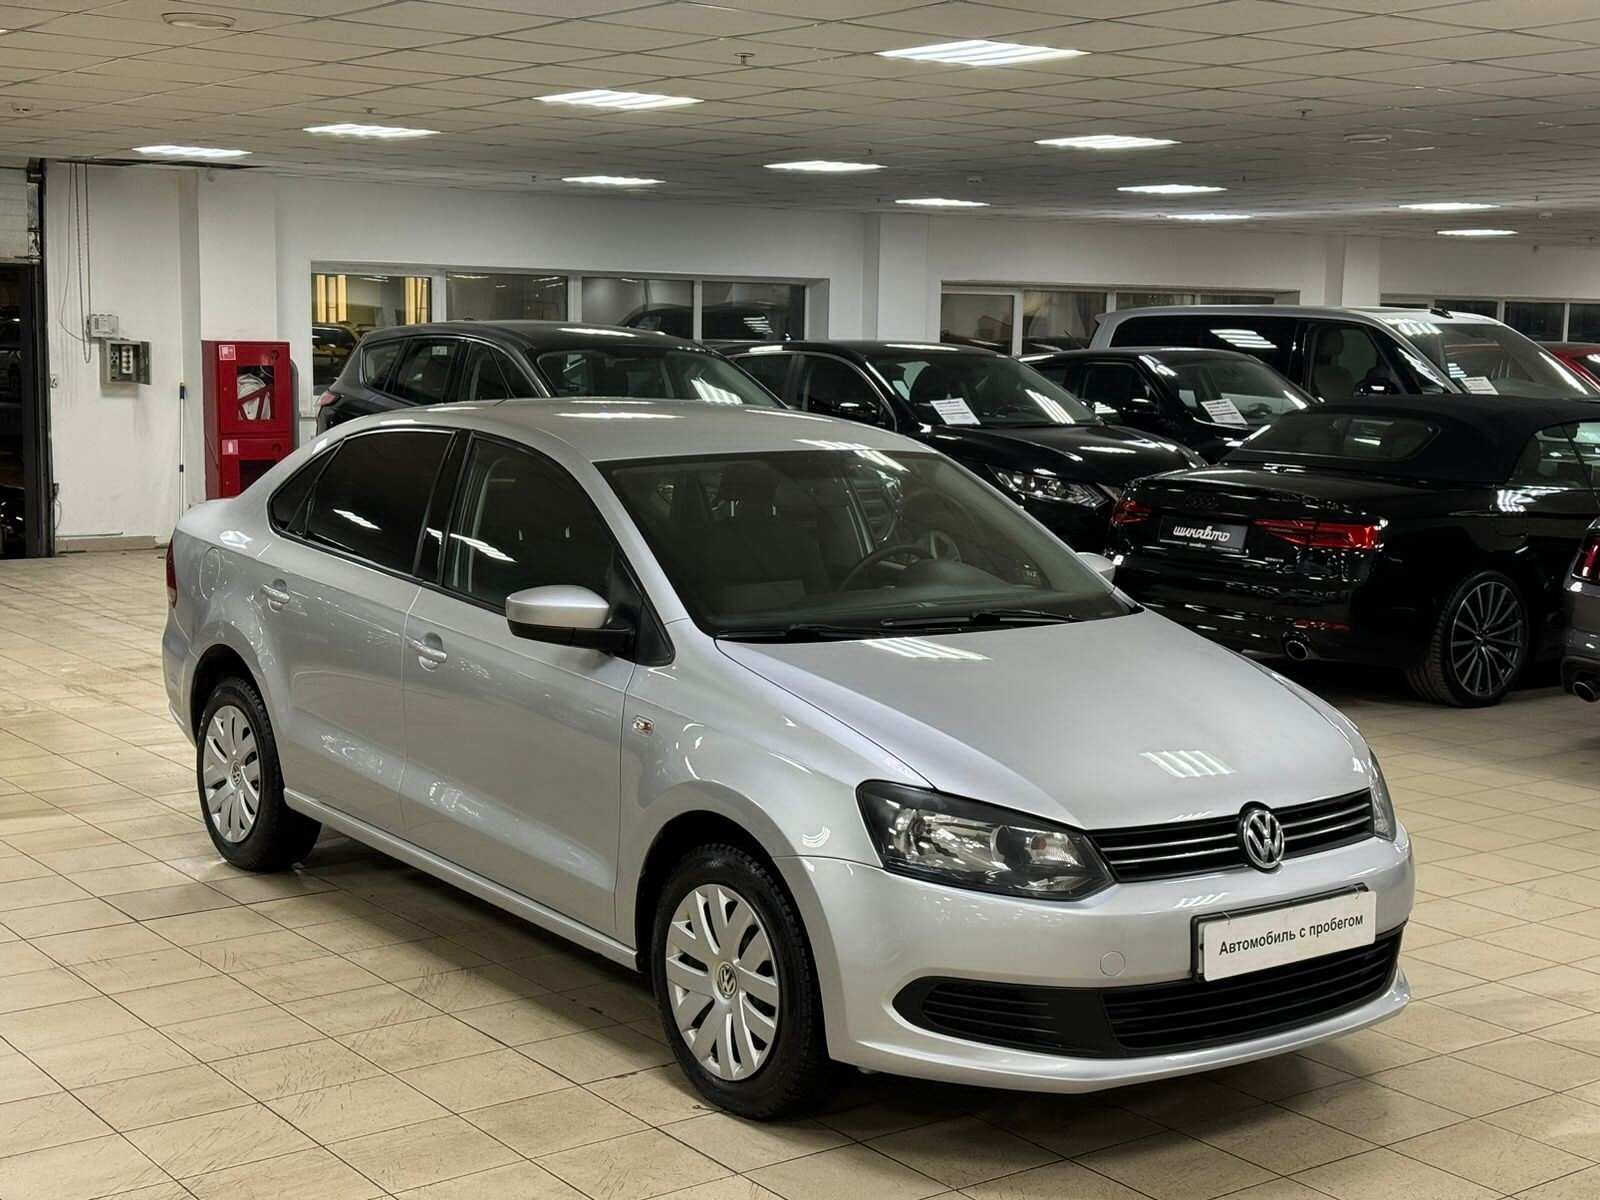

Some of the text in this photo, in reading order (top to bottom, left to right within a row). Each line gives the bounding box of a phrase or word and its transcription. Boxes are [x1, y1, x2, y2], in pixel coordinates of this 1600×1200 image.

[1245, 810, 1285, 868] VW
[1219, 914, 1363, 956] Автомобиль с пробегом
